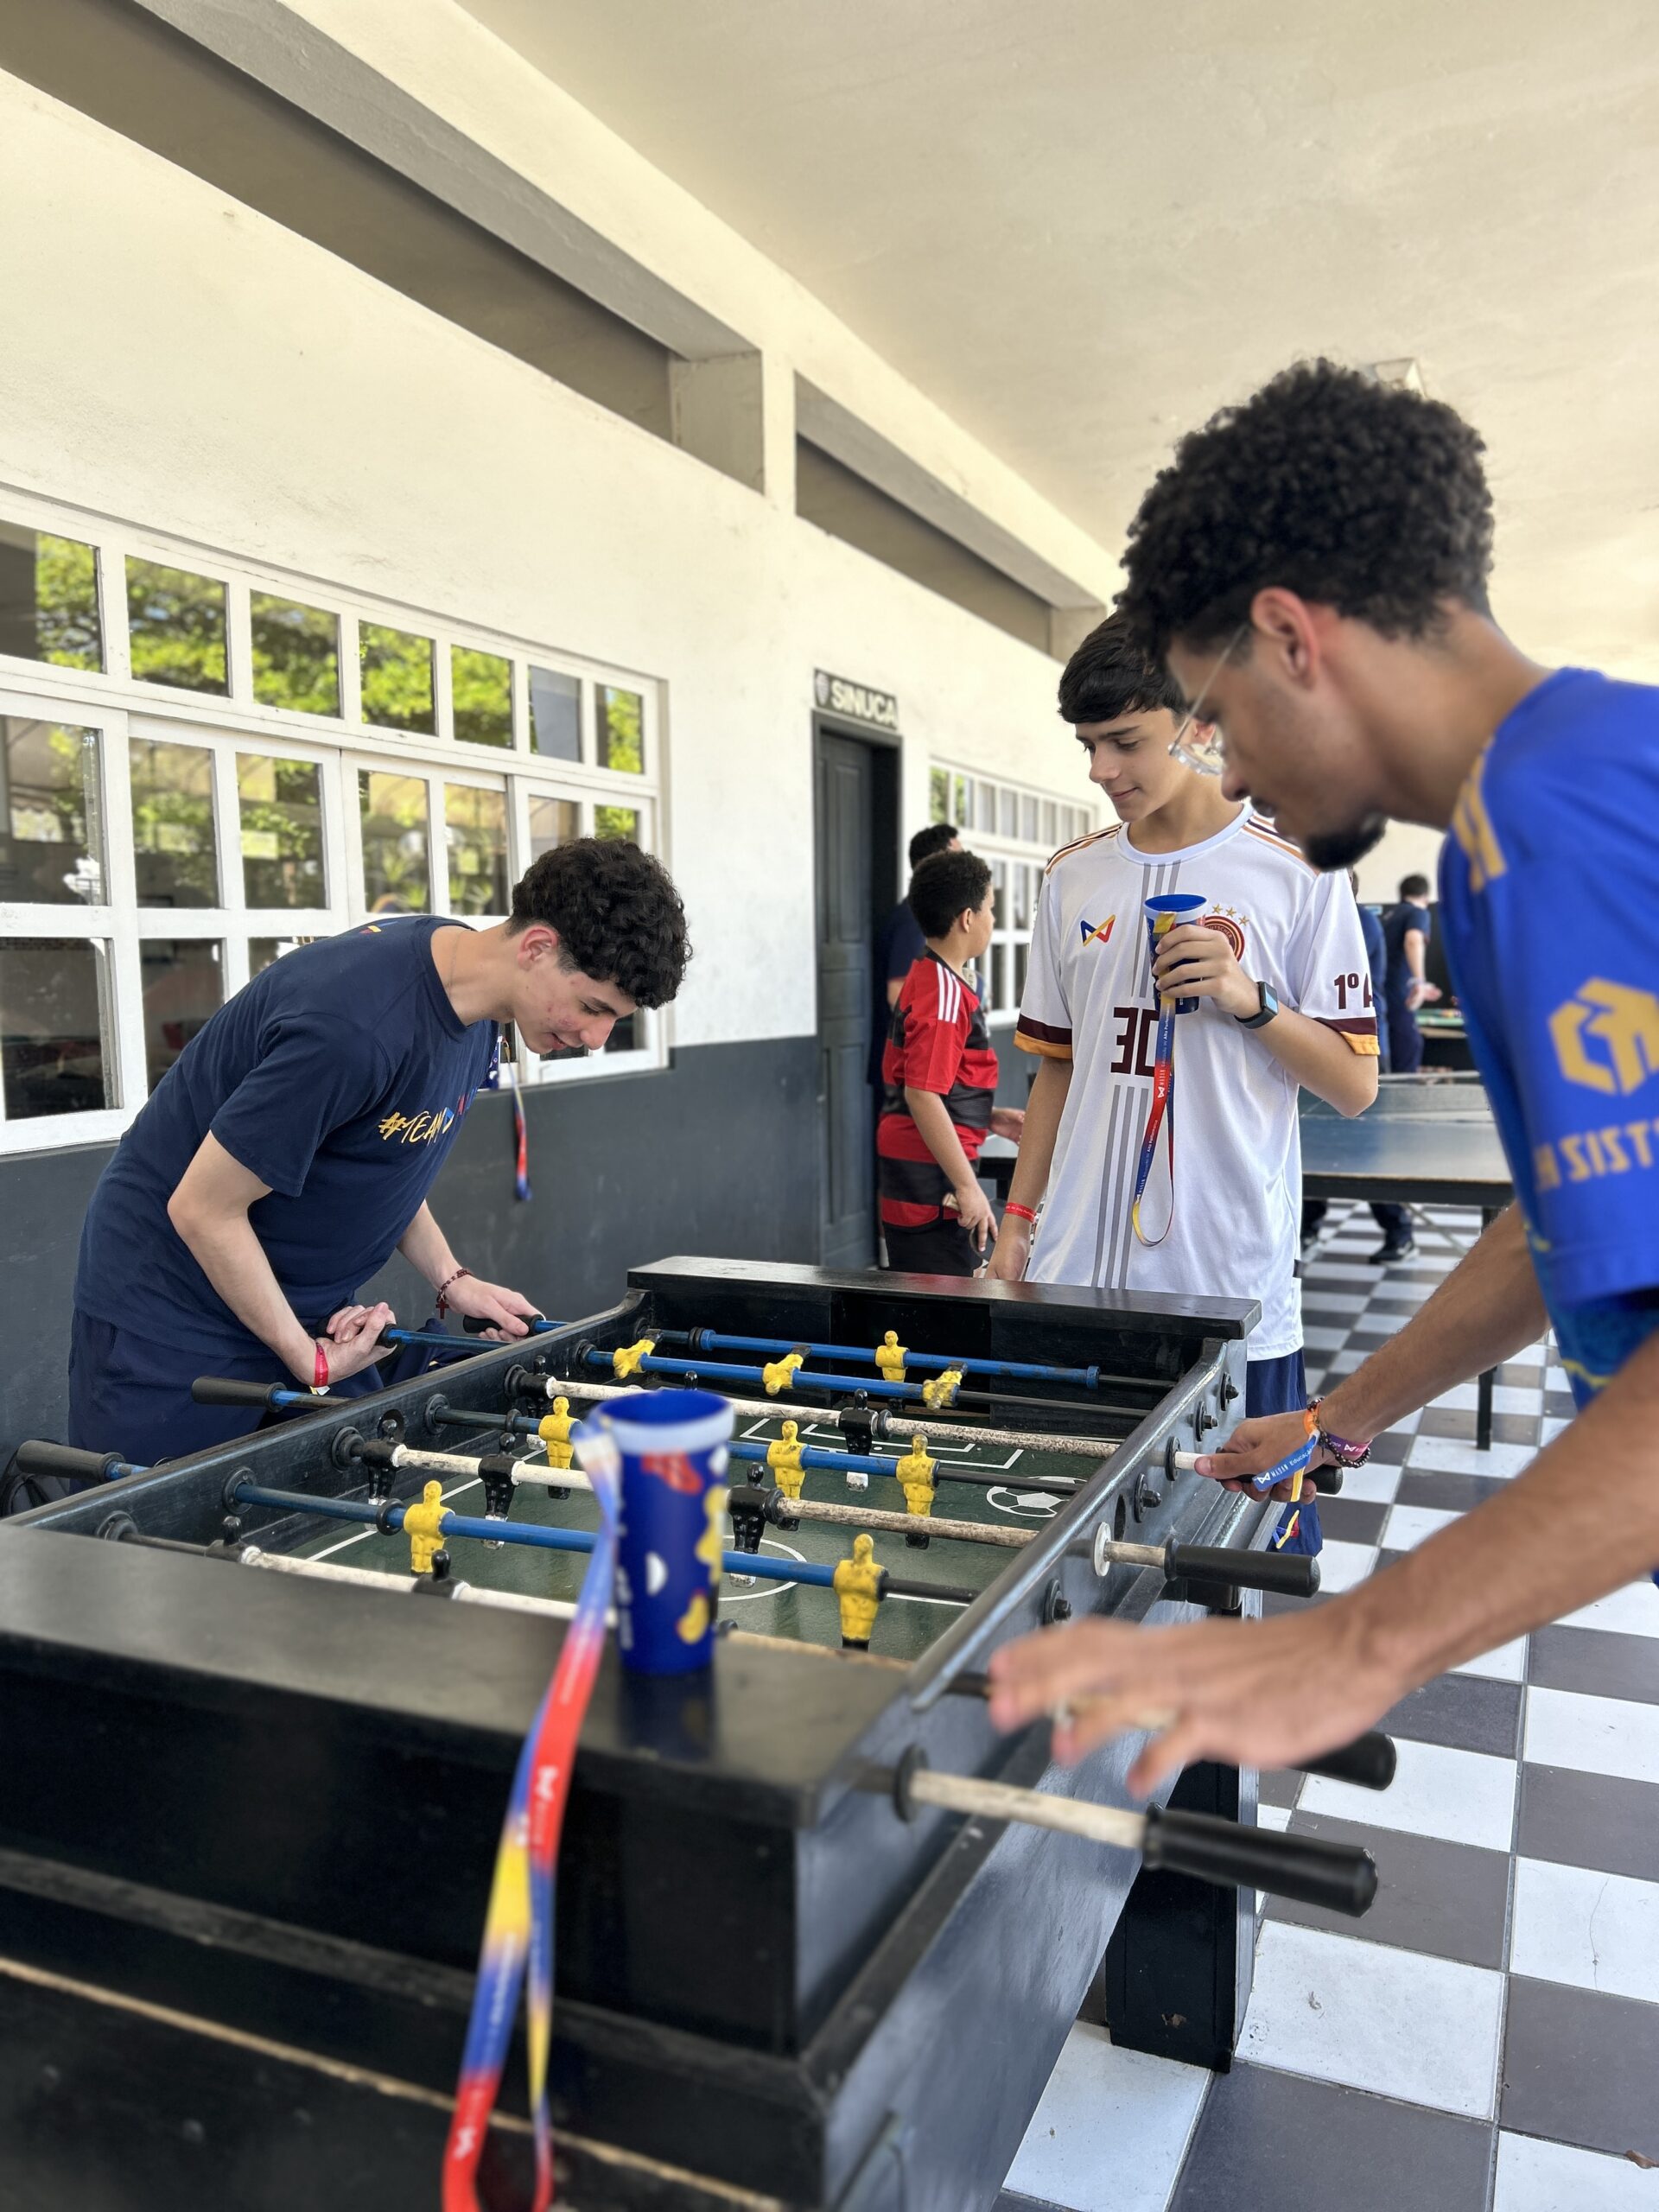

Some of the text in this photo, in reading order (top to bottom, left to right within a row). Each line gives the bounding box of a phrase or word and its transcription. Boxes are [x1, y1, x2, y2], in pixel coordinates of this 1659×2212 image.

[831, 678, 897, 726] SINUCA
[1110, 1007, 1160, 1077] 30
[1559, 1118, 1659, 1182] SIST
